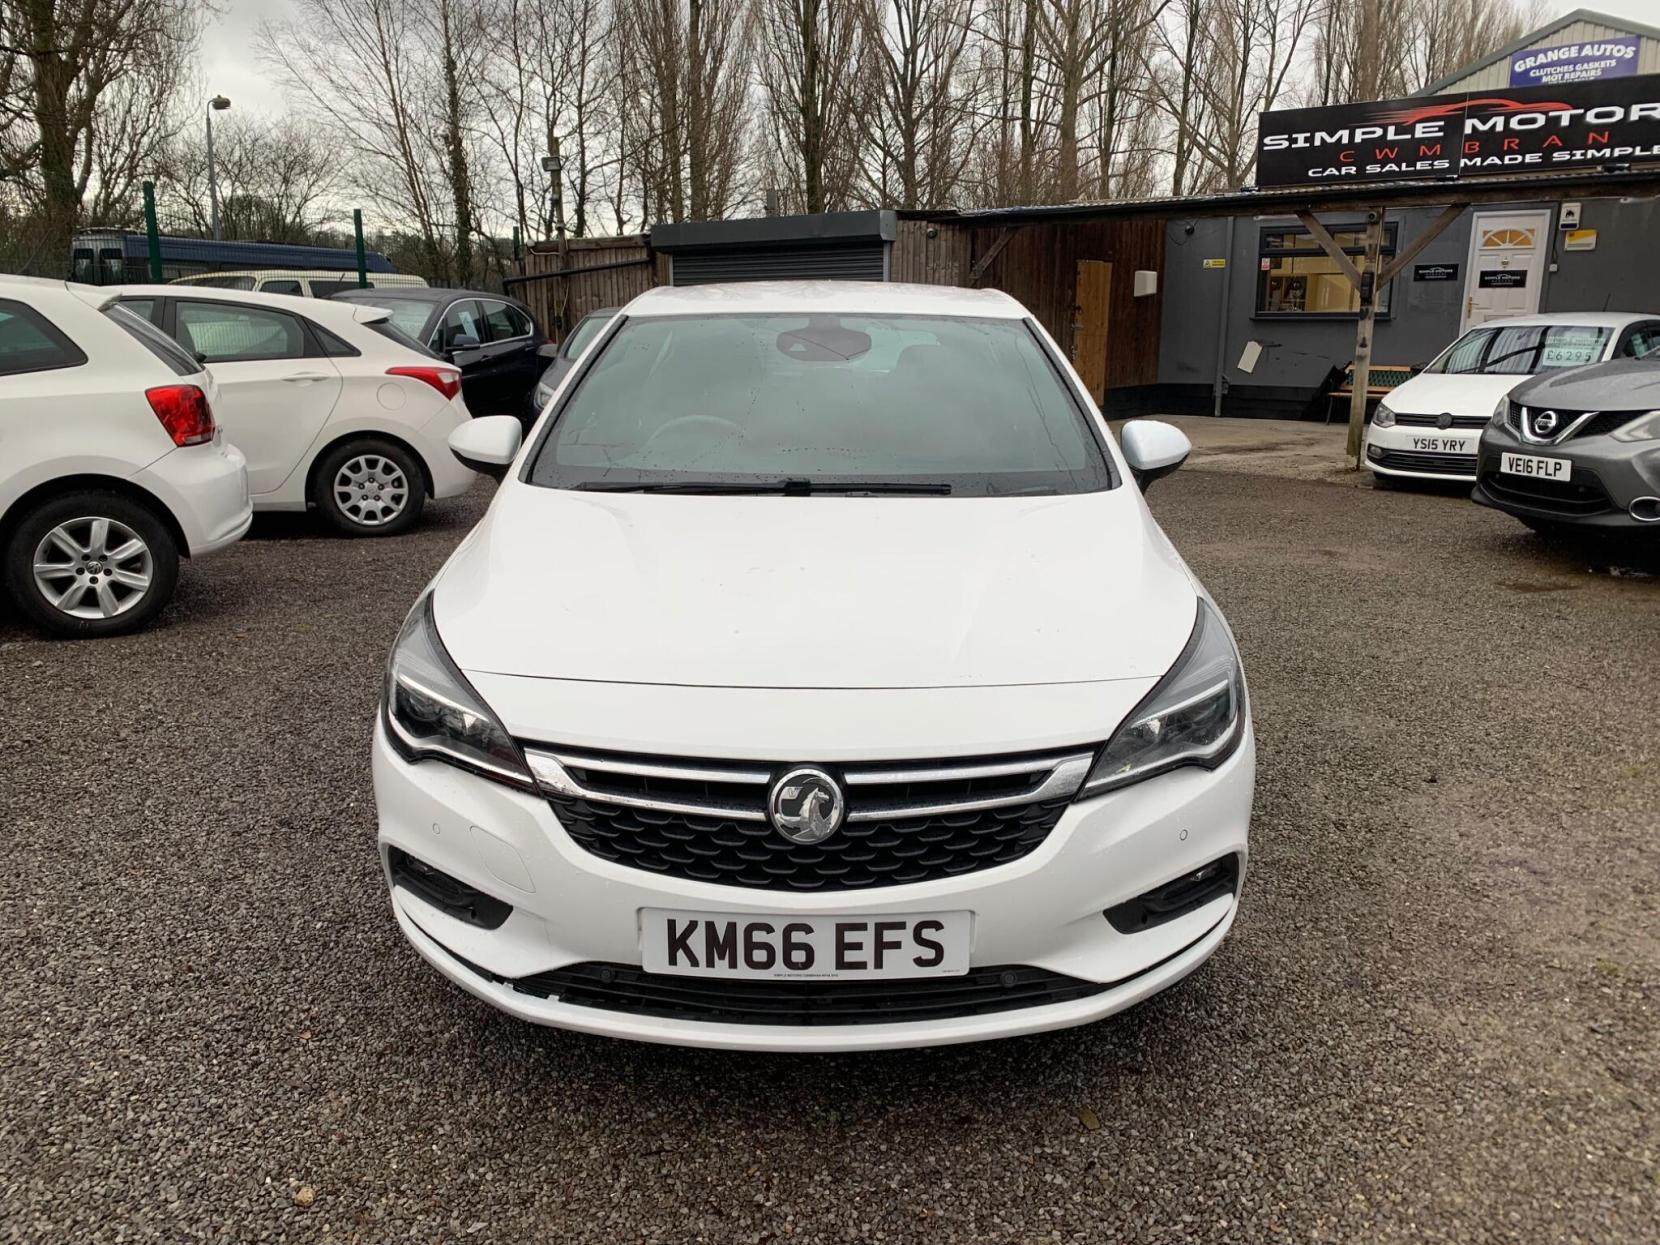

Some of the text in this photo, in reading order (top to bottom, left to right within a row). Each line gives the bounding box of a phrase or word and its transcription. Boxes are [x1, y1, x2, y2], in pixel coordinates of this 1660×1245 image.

[1514, 44, 1637, 72] GRANGE AUTOS
[1530, 59, 1617, 77] CLUTCHES GASKETS
[1541, 74, 1563, 83] MOT
[1564, 69, 1602, 80] REPAIRS
[1263, 103, 1660, 150] SIMPLE MOTOR
[1339, 131, 1609, 162] CWMBRAN
[1308, 166, 1356, 177] CAR
[1365, 159, 1450, 174] SALES
[1459, 153, 1541, 168] MADE
[1413, 438, 1466, 451] YS15 YRY
[1508, 456, 1562, 477] VE16 FLP
[667, 918, 945, 971] KM66 EFS
